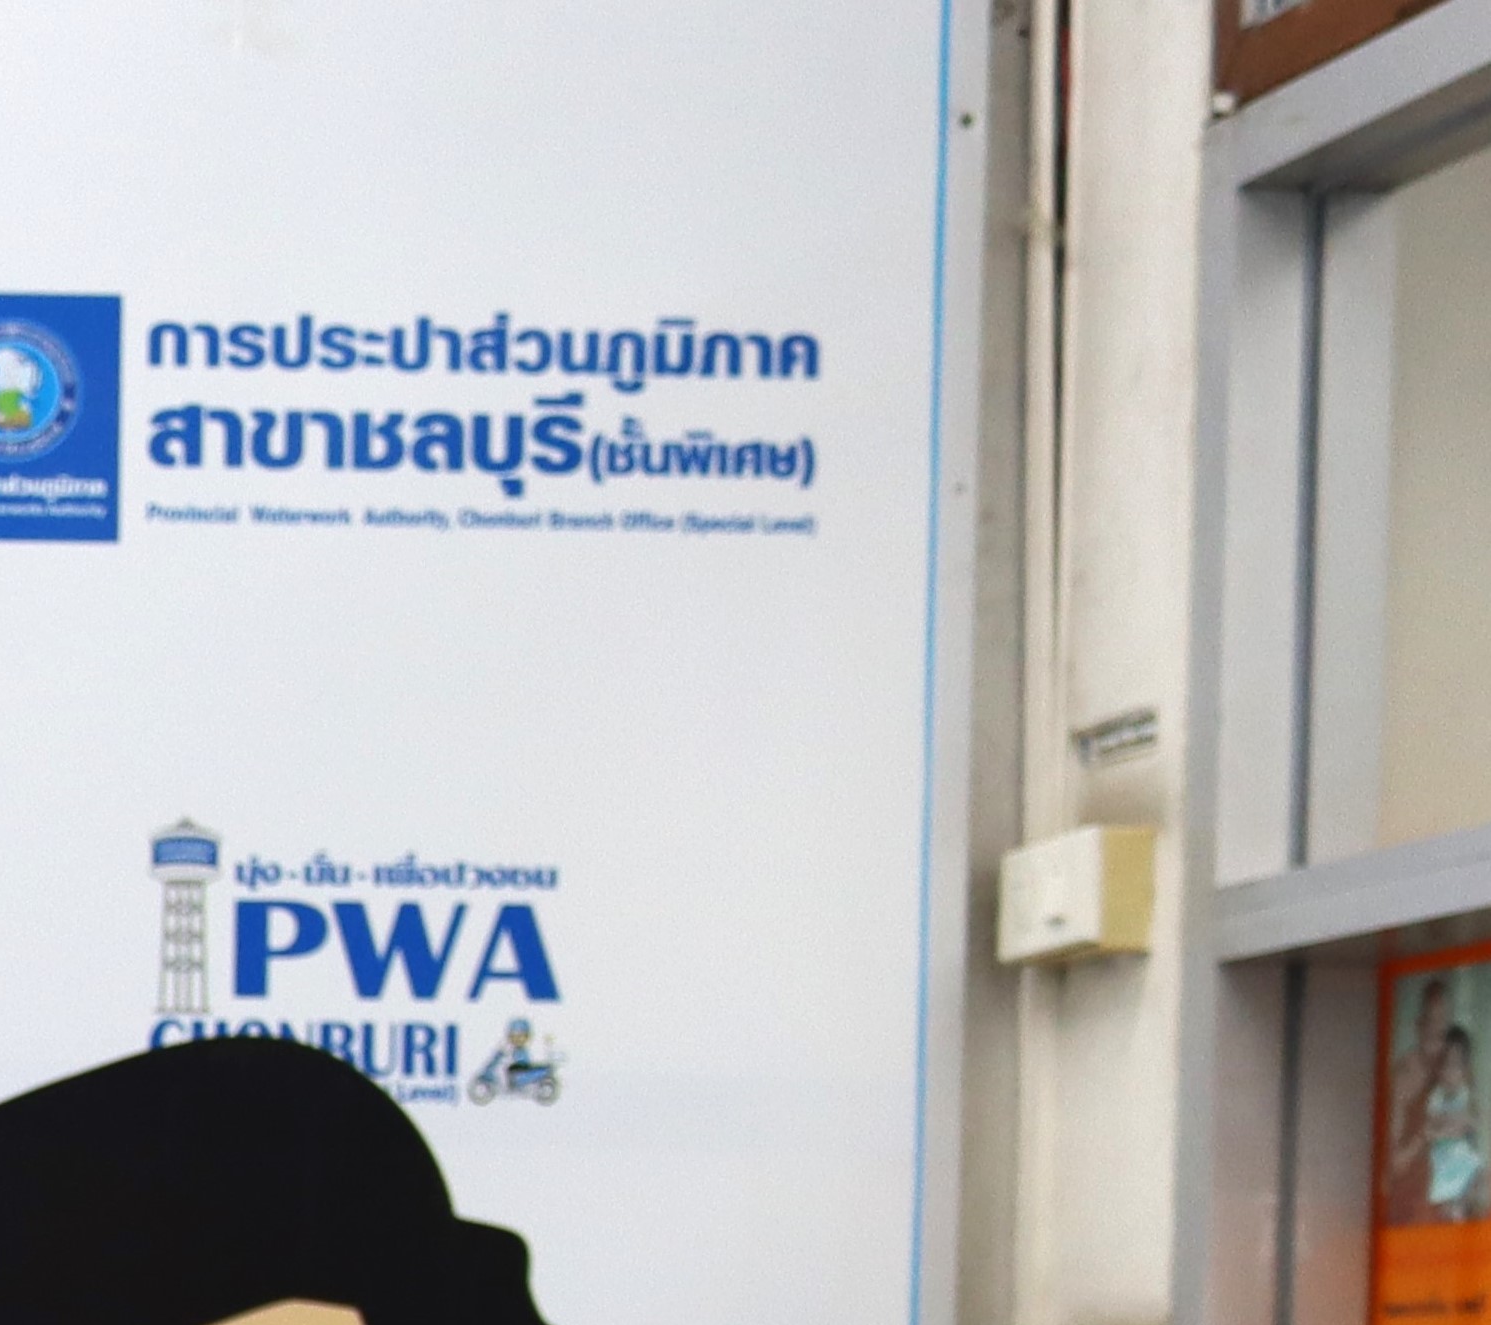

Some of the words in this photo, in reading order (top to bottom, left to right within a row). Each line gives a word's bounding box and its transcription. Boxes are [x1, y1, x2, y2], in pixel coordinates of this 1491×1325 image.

[146, 312, 820, 392] การประปาส่วนภูมิภาค
[146, 393, 814, 497] สาขาชลบุรี(ชั้นพิเศษ)
[234, 900, 561, 1002] PWA
